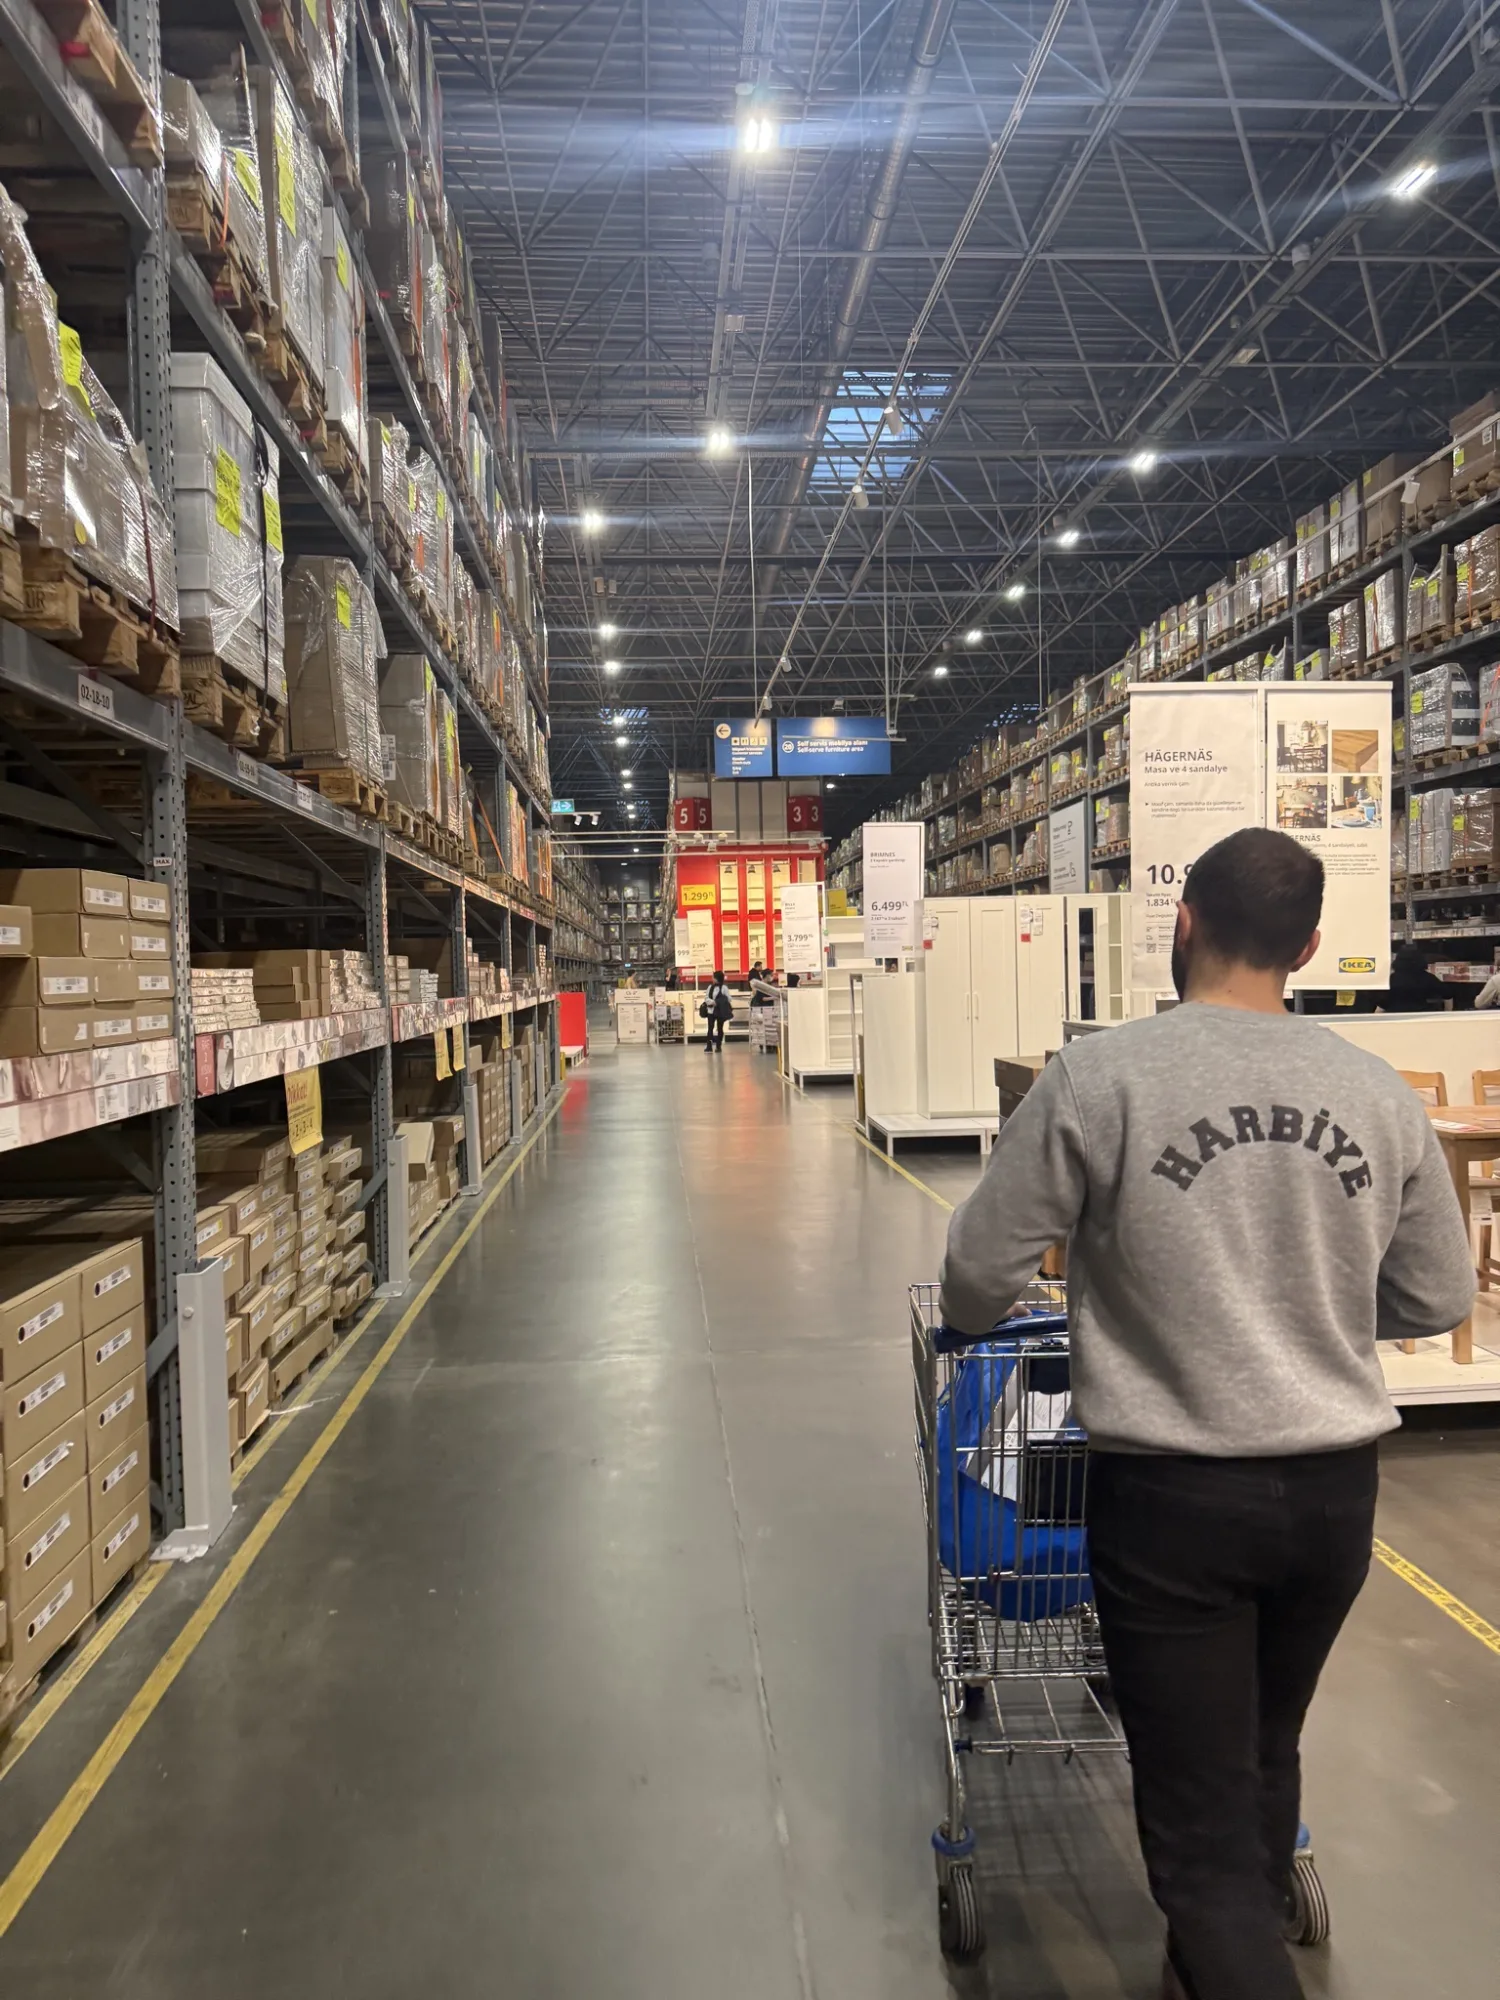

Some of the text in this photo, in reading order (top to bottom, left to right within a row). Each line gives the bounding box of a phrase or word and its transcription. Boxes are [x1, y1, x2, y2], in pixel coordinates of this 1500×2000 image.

[1144, 748, 1213, 762] HÄGERNÄS
[1189, 764, 1228, 774] sandalye
[680, 808, 688, 824] 5
[699, 808, 706, 824] 5
[793, 806, 802, 822] 3
[811, 806, 819, 822] 3
[1150, 1104, 1373, 1199] HARBİYE
